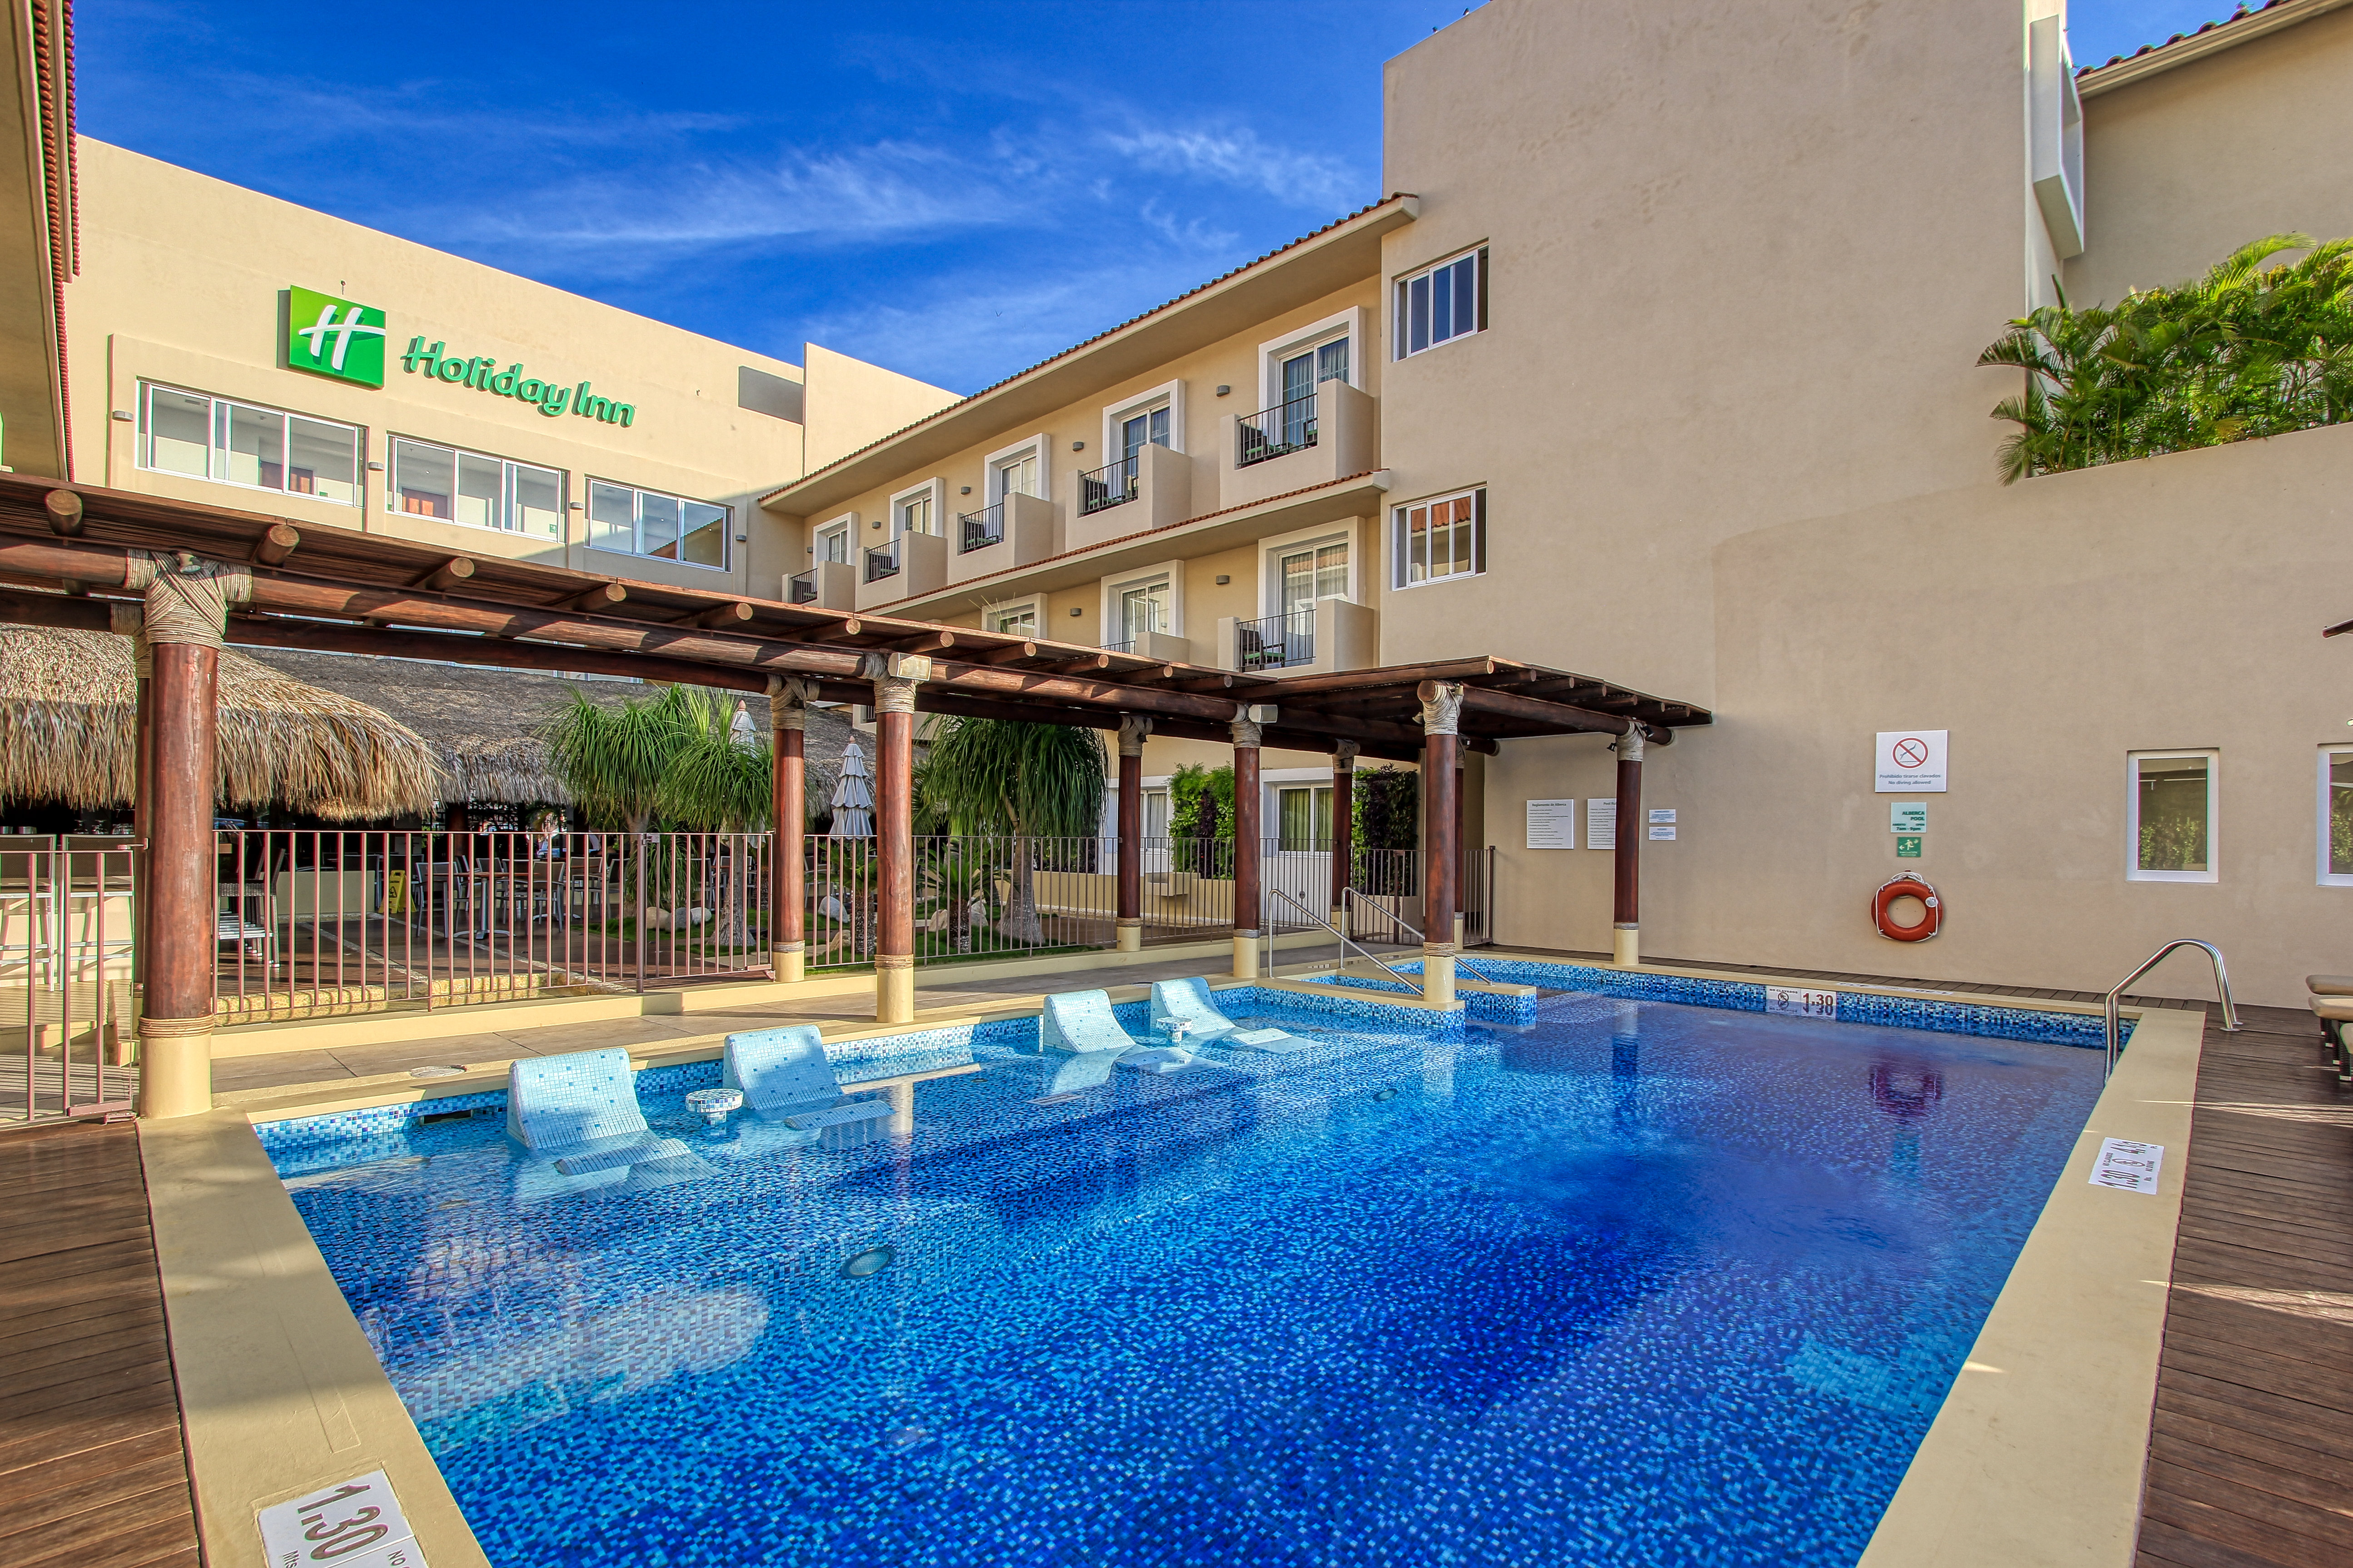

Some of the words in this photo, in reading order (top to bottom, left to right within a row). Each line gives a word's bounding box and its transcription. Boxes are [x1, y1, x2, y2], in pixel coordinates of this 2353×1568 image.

[400, 335, 571, 417] Holiday
[571, 381, 635, 428] Inn
[1803, 992, 1834, 1006] 1.30
[2098, 1169, 2140, 1189] 1.30
[297, 1484, 388, 1560] 1.30
[387, 1549, 407, 1566] NO
